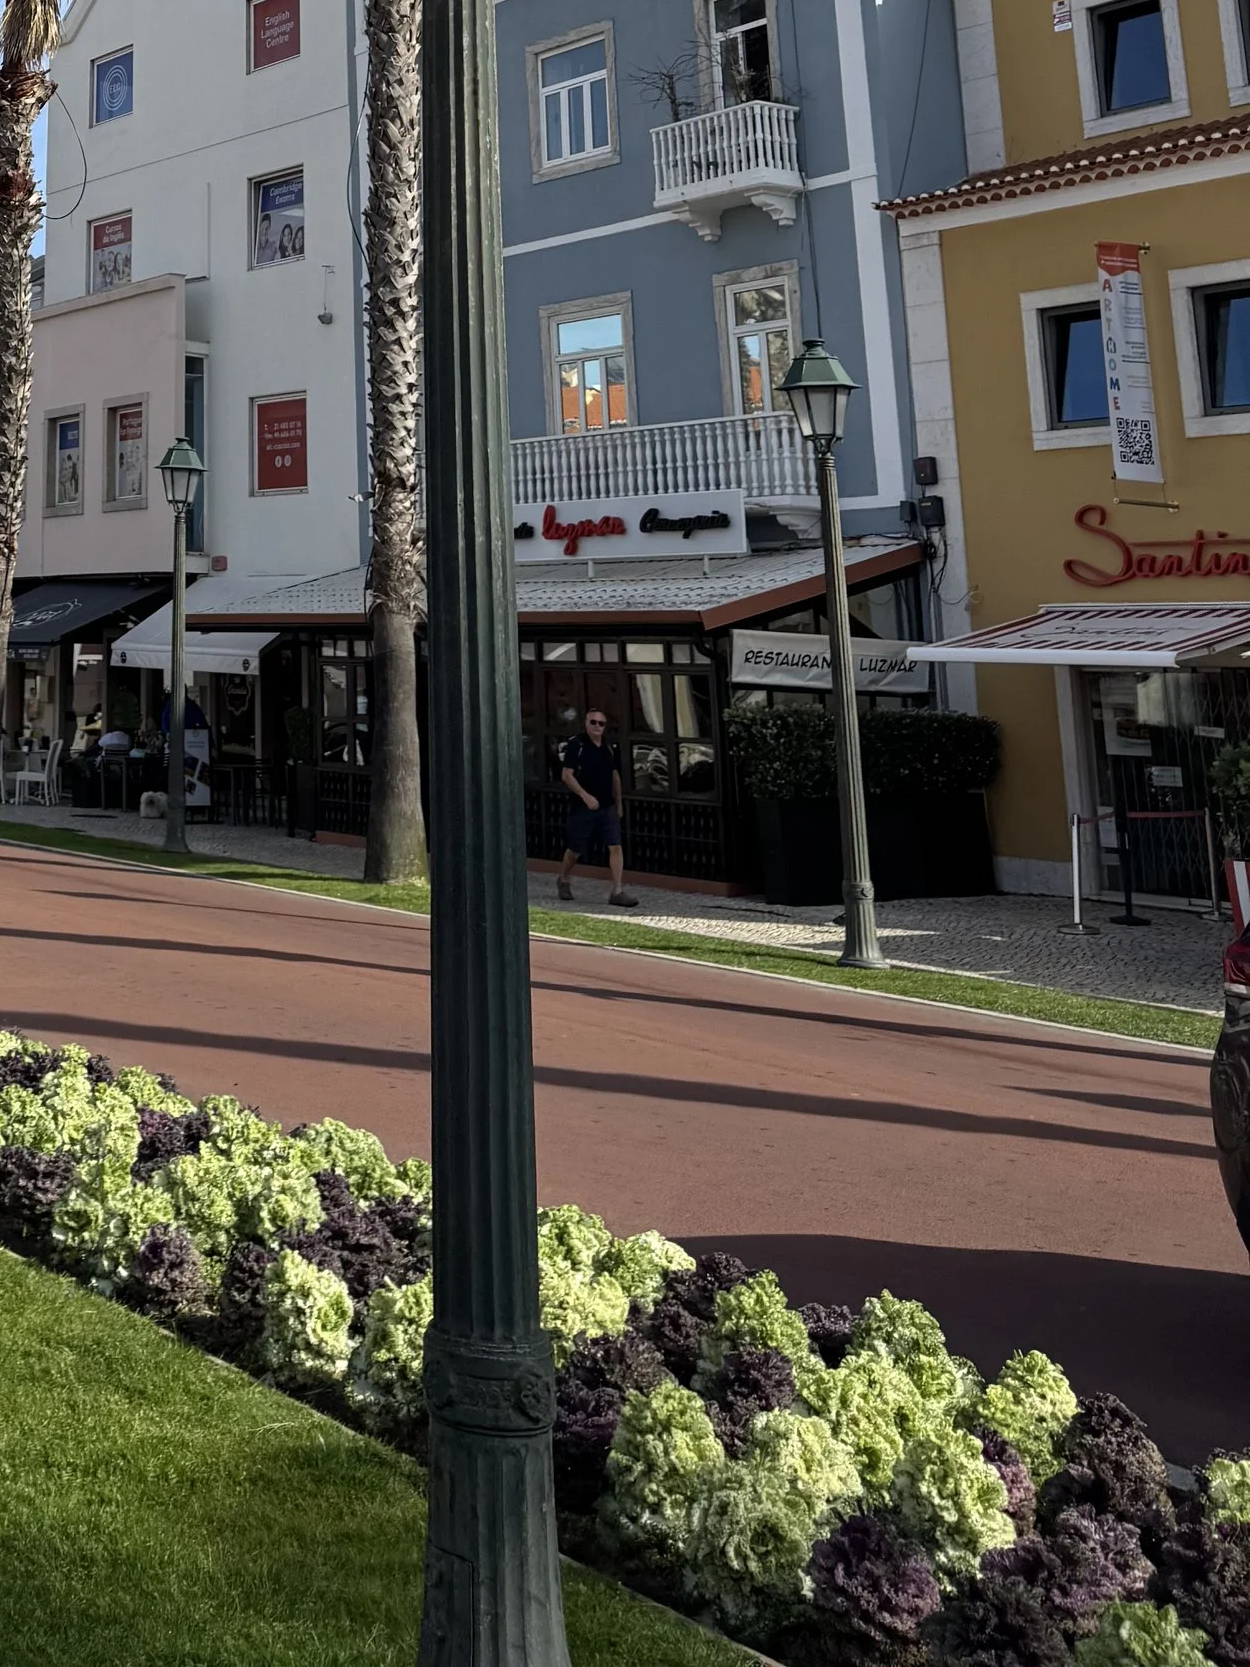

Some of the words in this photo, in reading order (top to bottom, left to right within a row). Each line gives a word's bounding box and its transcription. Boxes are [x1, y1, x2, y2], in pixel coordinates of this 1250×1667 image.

[265, 10, 290, 26] English
[261, 21, 294, 38] Language
[266, 34, 289, 48] Centre
[270, 182, 303, 196] Cambridge
[1062, 503, 1250, 587] Santin
[744, 649, 833, 670] RESTAURAN
[859, 658, 917, 673] LUZMAR
